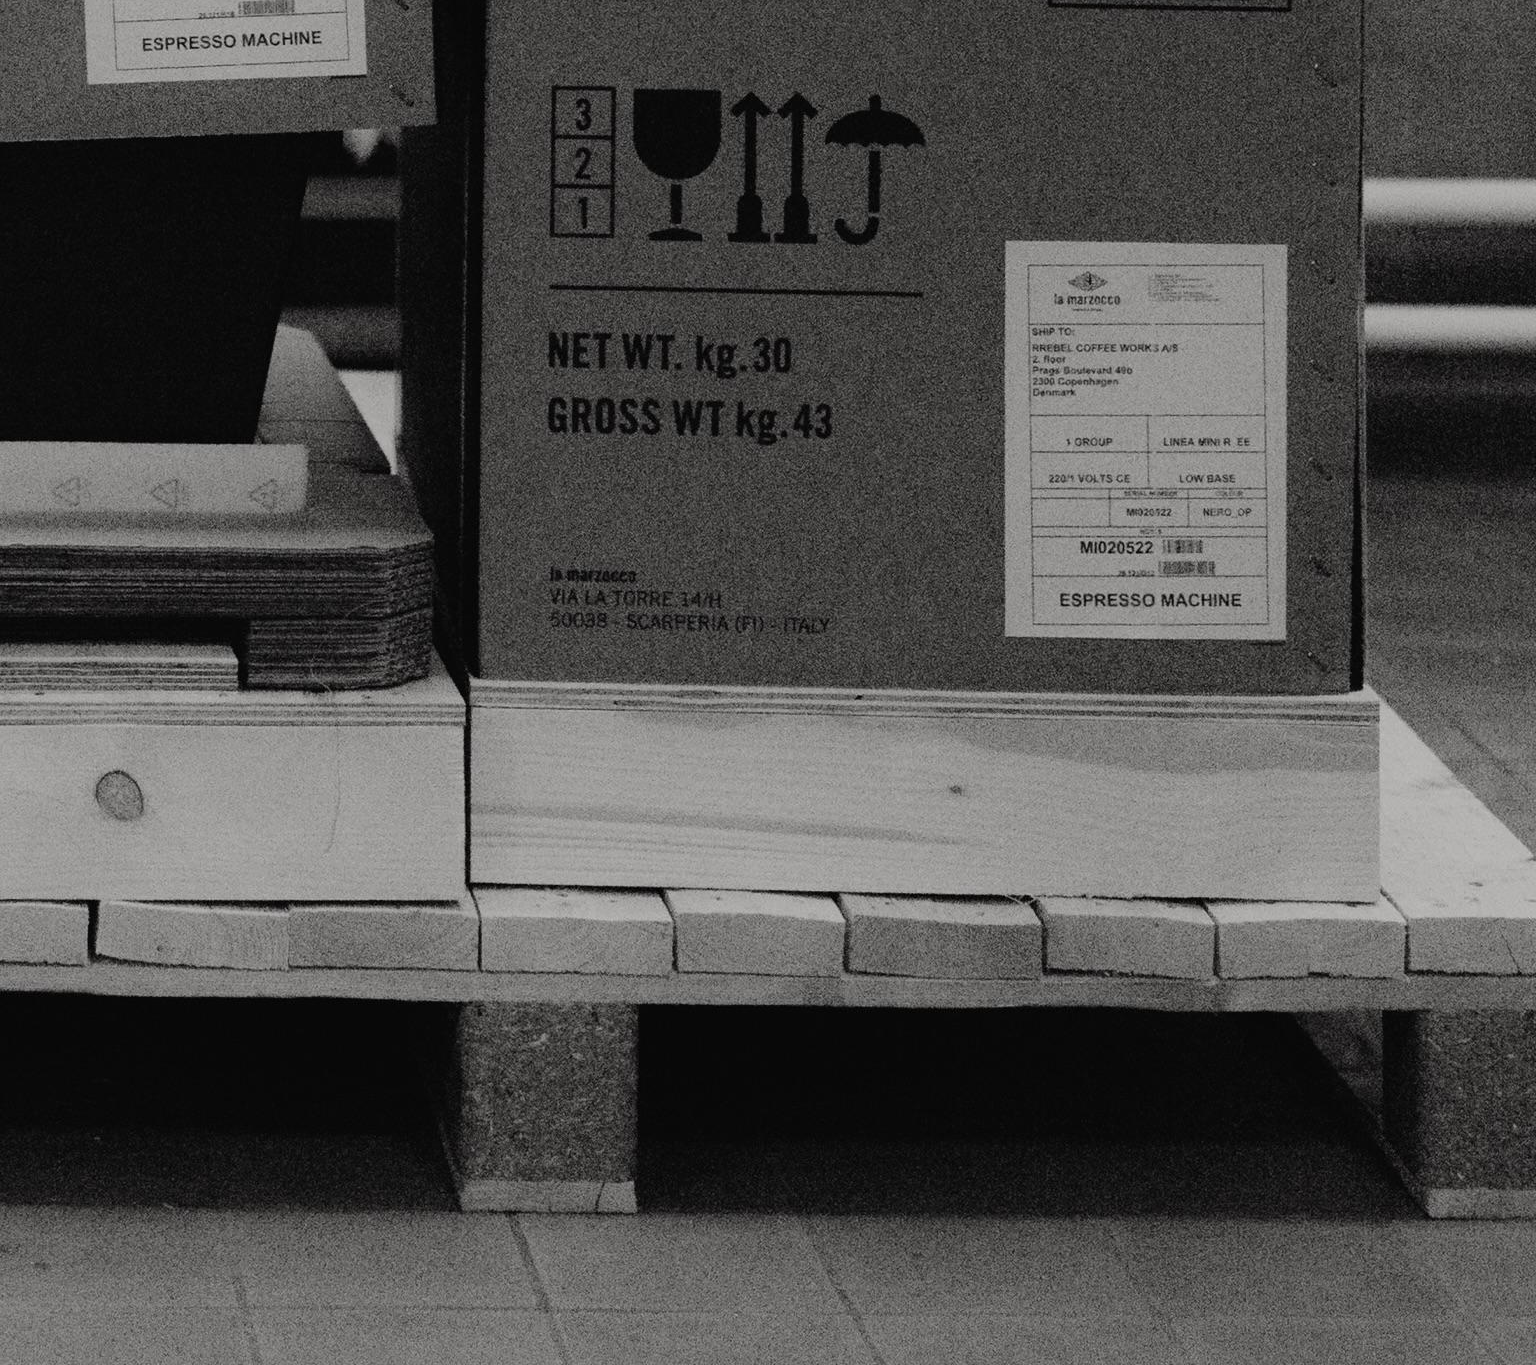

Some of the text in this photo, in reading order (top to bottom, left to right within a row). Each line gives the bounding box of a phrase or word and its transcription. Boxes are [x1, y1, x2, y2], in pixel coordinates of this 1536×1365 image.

[142, 31, 323, 51] ESPRESSO MACHINE
[576, 98, 591, 131] 3
[575, 147, 592, 180] 2
[578, 197, 588, 228] 1
[1066, 296, 1122, 305] marzocco
[548, 332, 792, 379] NET WT. kg.30
[548, 397, 832, 446] GROSS WT kg.43
[1079, 541, 1154, 554] MI020522
[550, 567, 636, 583] la marzocco
[550, 589, 722, 608] VIA LA TORRE 14/H
[1059, 593, 1242, 607] ESPRESSO MACHINE
[550, 611, 829, 634] 50038 SCARPERIA (FI) ITALY
